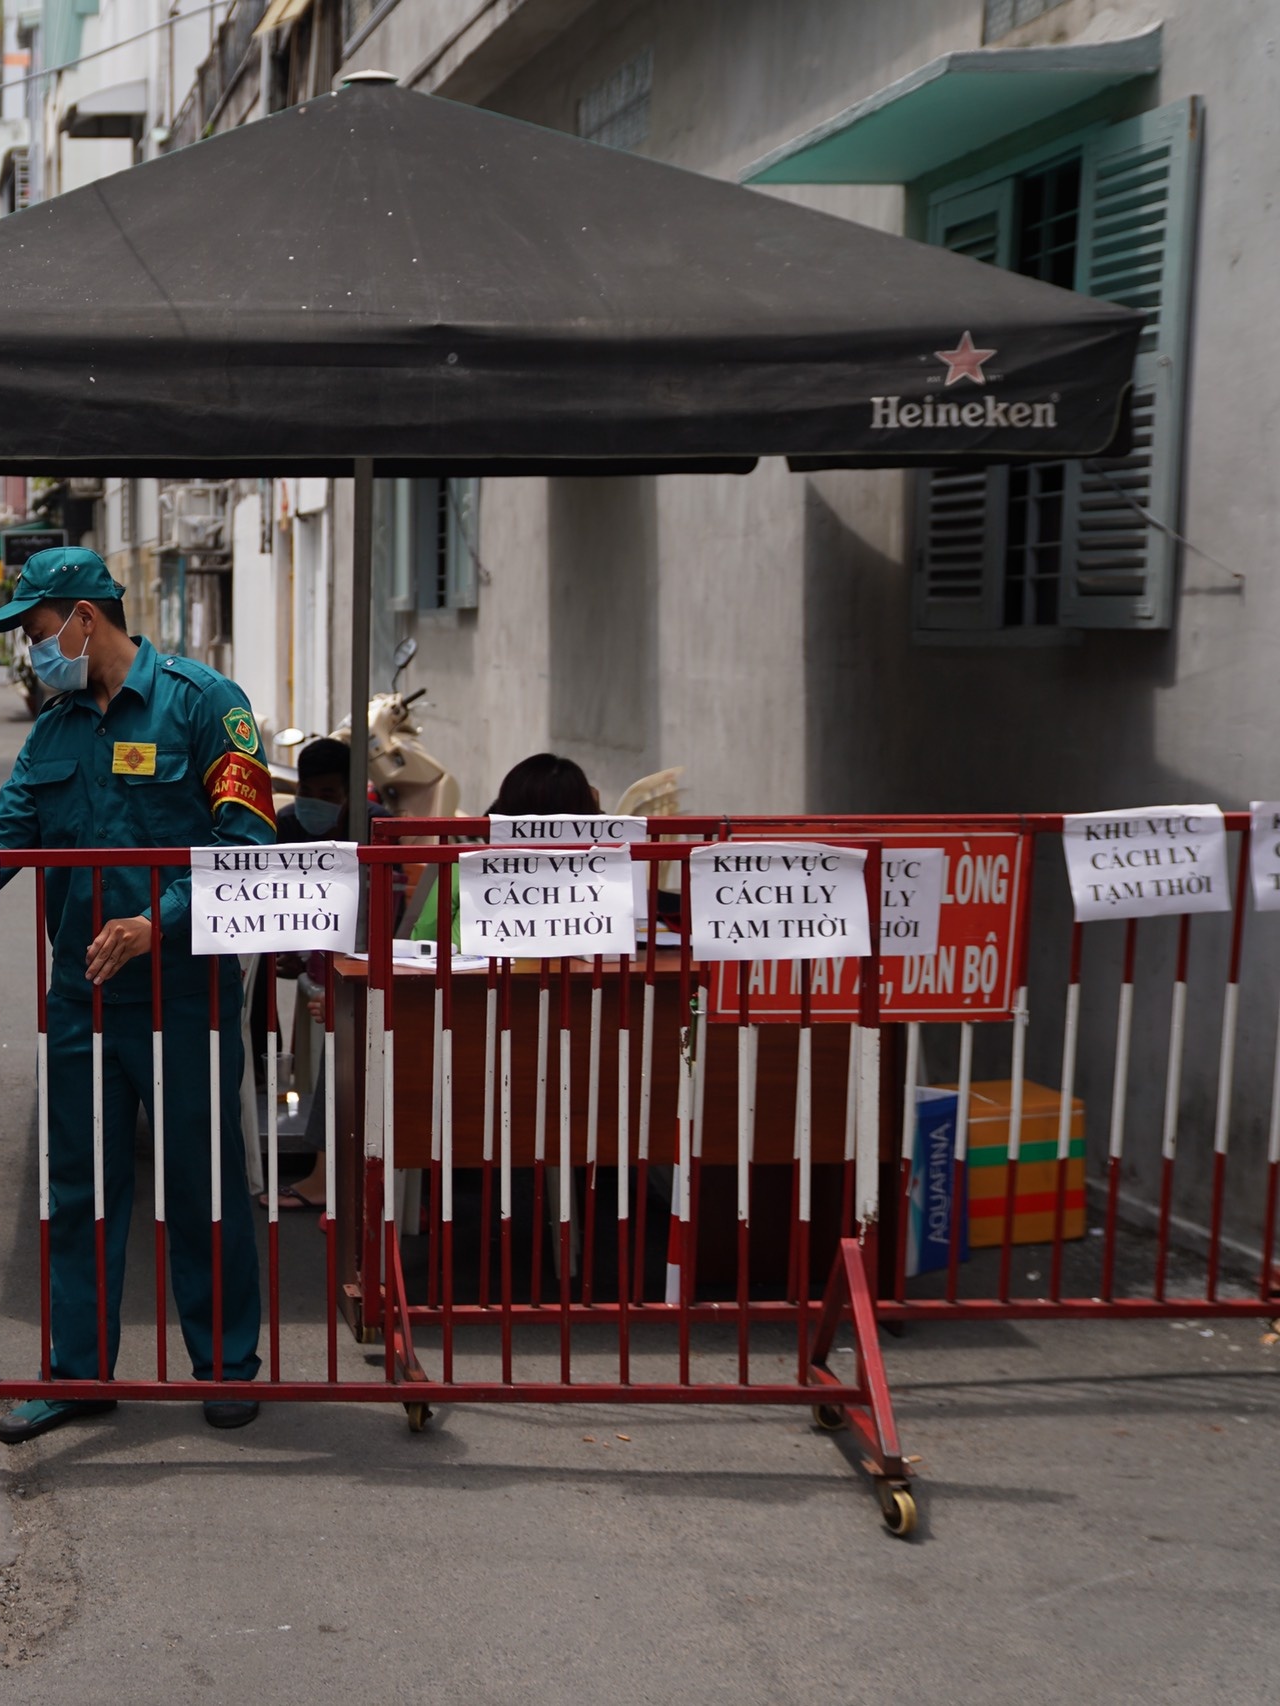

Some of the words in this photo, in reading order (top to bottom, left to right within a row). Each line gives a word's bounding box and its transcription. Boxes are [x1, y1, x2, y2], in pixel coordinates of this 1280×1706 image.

[870, 394, 1058, 429] Heineken
[233, 780, 257, 801] TRA
[511, 821, 564, 839] KHU
[571, 819, 624, 843] VỰC
[1084, 820, 1139, 841] KHU
[1146, 815, 1201, 839] VỰC
[212, 852, 269, 871] KHU
[277, 849, 335, 875] VỰC
[481, 856, 540, 875] KHU
[547, 853, 606, 877] VỰC
[712, 855, 772, 873] KHU
[781, 852, 840, 876] VỰC
[1091, 846, 1161, 870] CÁCH
[1169, 845, 1201, 864] LY
[881, 859, 921, 882] ỰC
[939, 841, 1009, 905] LÒNG
[215, 878, 289, 901] CÁCH
[298, 882, 332, 900] LY
[483, 881, 560, 905] CÁCH
[568, 885, 606, 903] LY
[715, 880, 793, 905] CÁCH
[801, 884, 837, 904] LY
[884, 890, 916, 907] LY
[1087, 881, 1145, 905] TẠM
[1150, 872, 1213, 896] THỜI
[206, 914, 265, 938] TẠM
[273, 908, 341, 932] THỜI
[475, 919, 536, 942] TẠM
[544, 911, 613, 937] THỜI
[707, 919, 770, 944] TẠM
[777, 913, 847, 939] THỜI
[880, 915, 920, 938] HỜI
[962, 931, 999, 1004] BỘ
[927, 1119, 952, 1244] AQUAFINA
